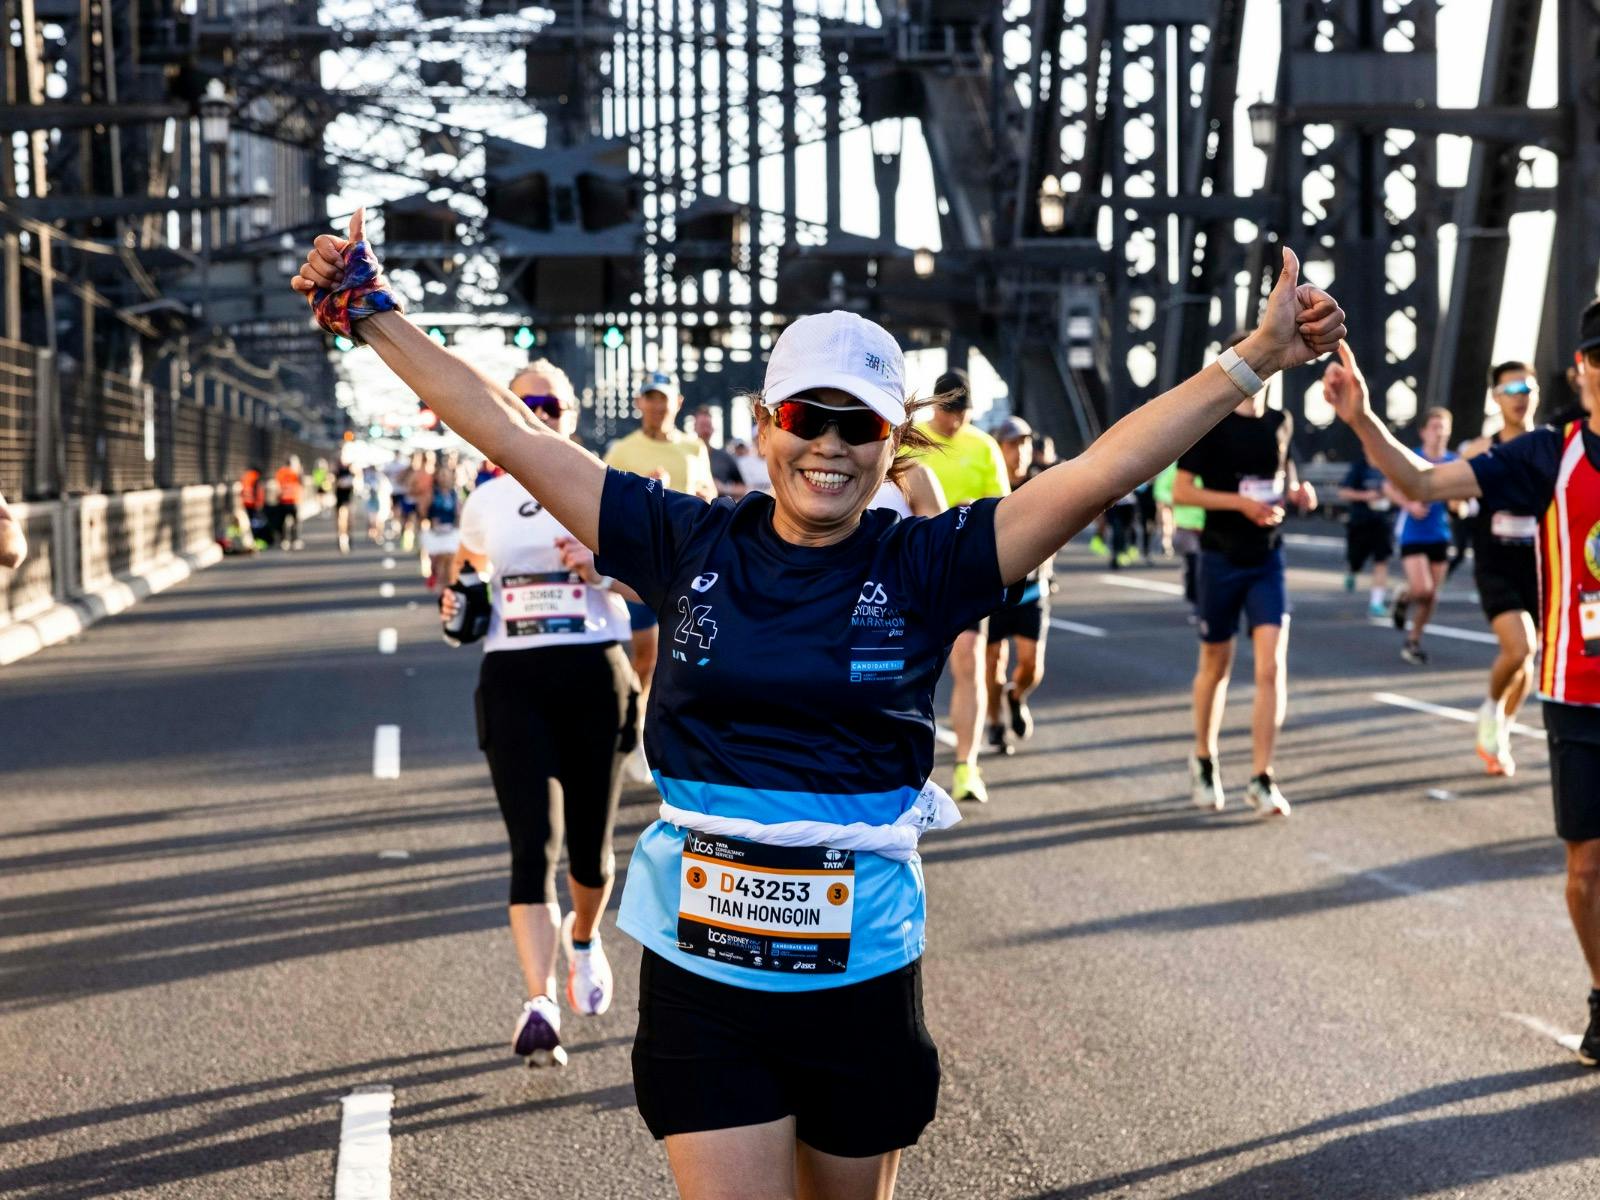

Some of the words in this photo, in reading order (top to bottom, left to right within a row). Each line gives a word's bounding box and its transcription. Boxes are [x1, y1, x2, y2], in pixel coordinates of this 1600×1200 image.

[852, 604, 887, 618] SYDNEY
[673, 595, 718, 650] 24
[851, 617, 905, 627] MARATHON
[823, 861, 843, 869] TATA
[692, 872, 701, 883] 3
[720, 872, 811, 903] D43253
[834, 888, 842, 900] 3
[708, 895, 743, 919] TIAN
[747, 902, 821, 927] HONGQIN
[727, 934, 750, 945] SYDNEY
